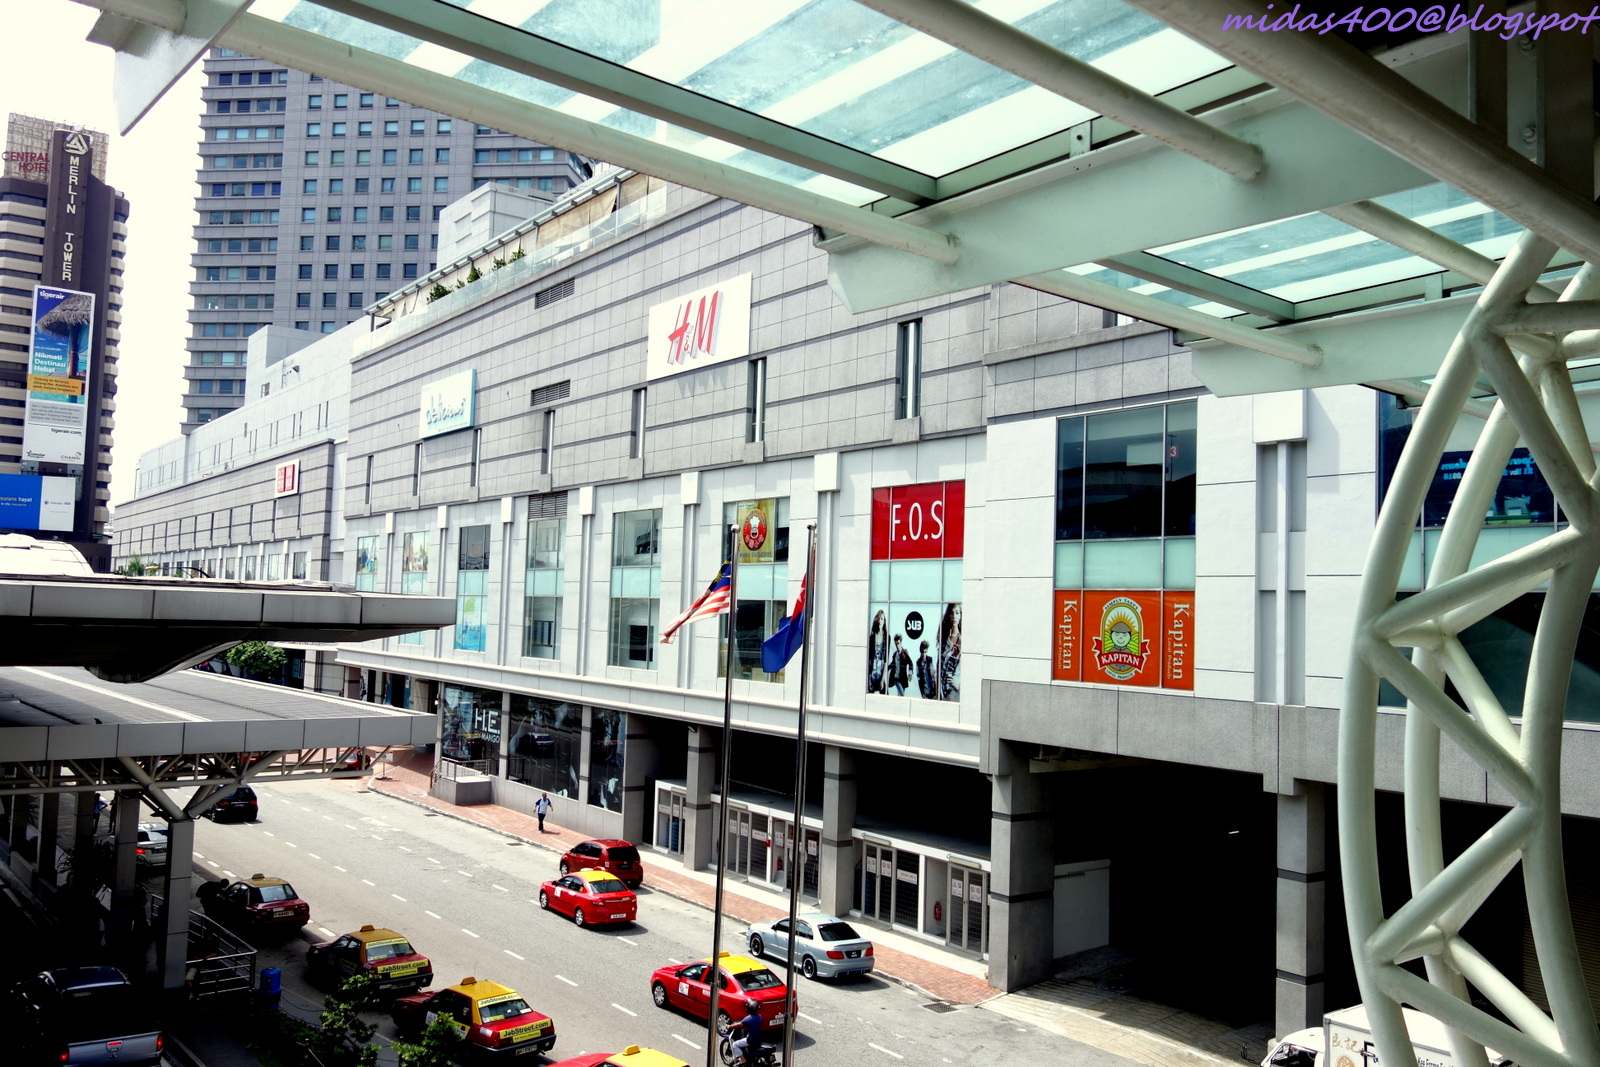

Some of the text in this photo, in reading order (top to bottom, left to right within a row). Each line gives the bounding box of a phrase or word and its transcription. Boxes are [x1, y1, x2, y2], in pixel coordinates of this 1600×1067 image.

[1, 151, 50, 163] CENTRAL
[18, 161, 50, 173] HOTEL
[62, 155, 80, 282] MERLIN TOWER
[39, 290, 65, 300] tigerair
[667, 290, 720, 365] H&M
[34, 352, 63, 361] Nikmati
[33, 365, 56, 373] Hebat
[34, 359, 66, 368] Destinasi
[51, 427, 83, 435] tigerair.com
[1170, 446, 1176, 457] 3
[891, 500, 943, 541] F.O.S
[907, 620, 922, 630] SUB
[1059, 600, 1077, 670] Kapitan
[1168, 602, 1190, 680] Kapitan
[1101, 653, 1140, 666] KAPITAN
[481, 732, 500, 743] MANGO
[380, 961, 426, 973] JobStreet.com
[503, 1021, 549, 1037] JobStreet.com
